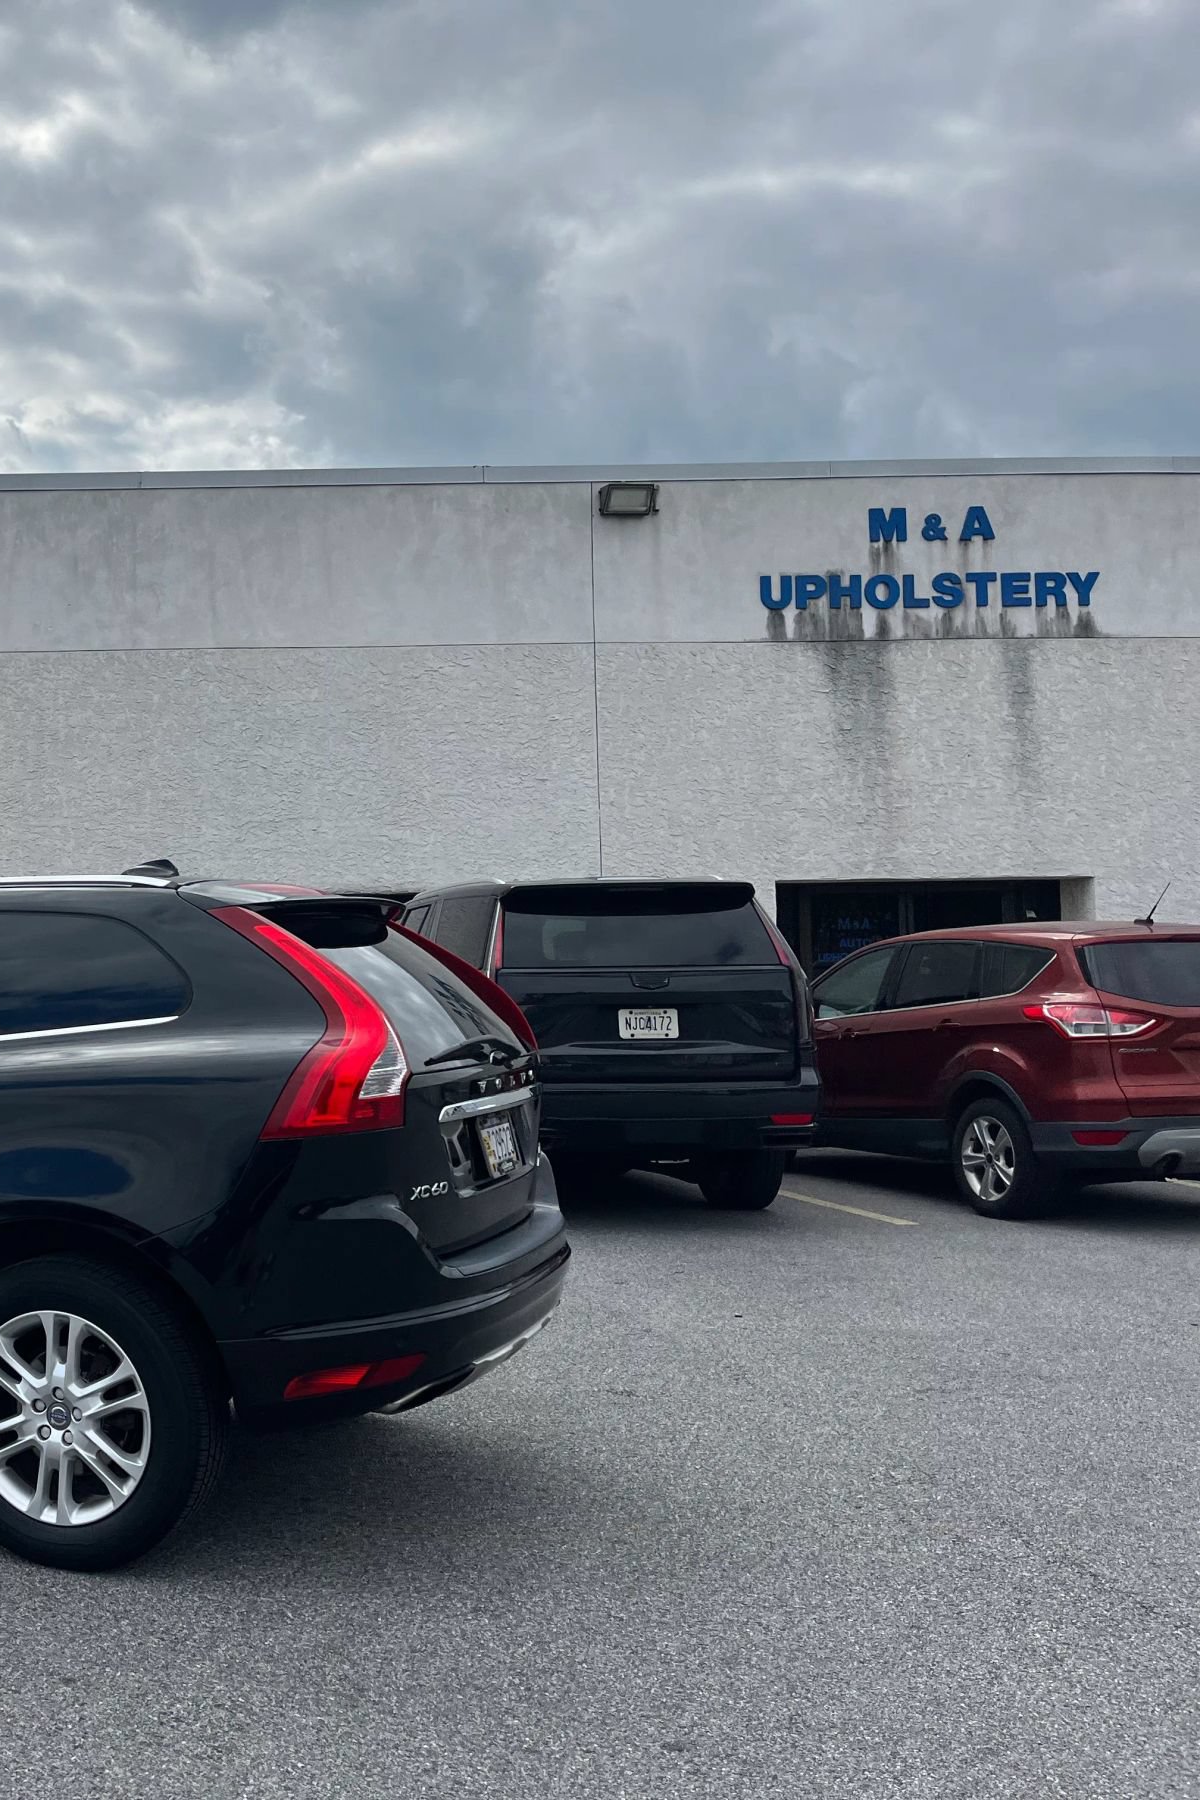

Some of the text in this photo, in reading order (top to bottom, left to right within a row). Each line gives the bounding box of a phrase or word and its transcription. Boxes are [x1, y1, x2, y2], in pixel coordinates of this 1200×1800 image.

[868, 506, 996, 542] M & A
[759, 571, 1100, 610] UPHOLSTERY
[410, 1181, 449, 1201] XC60
